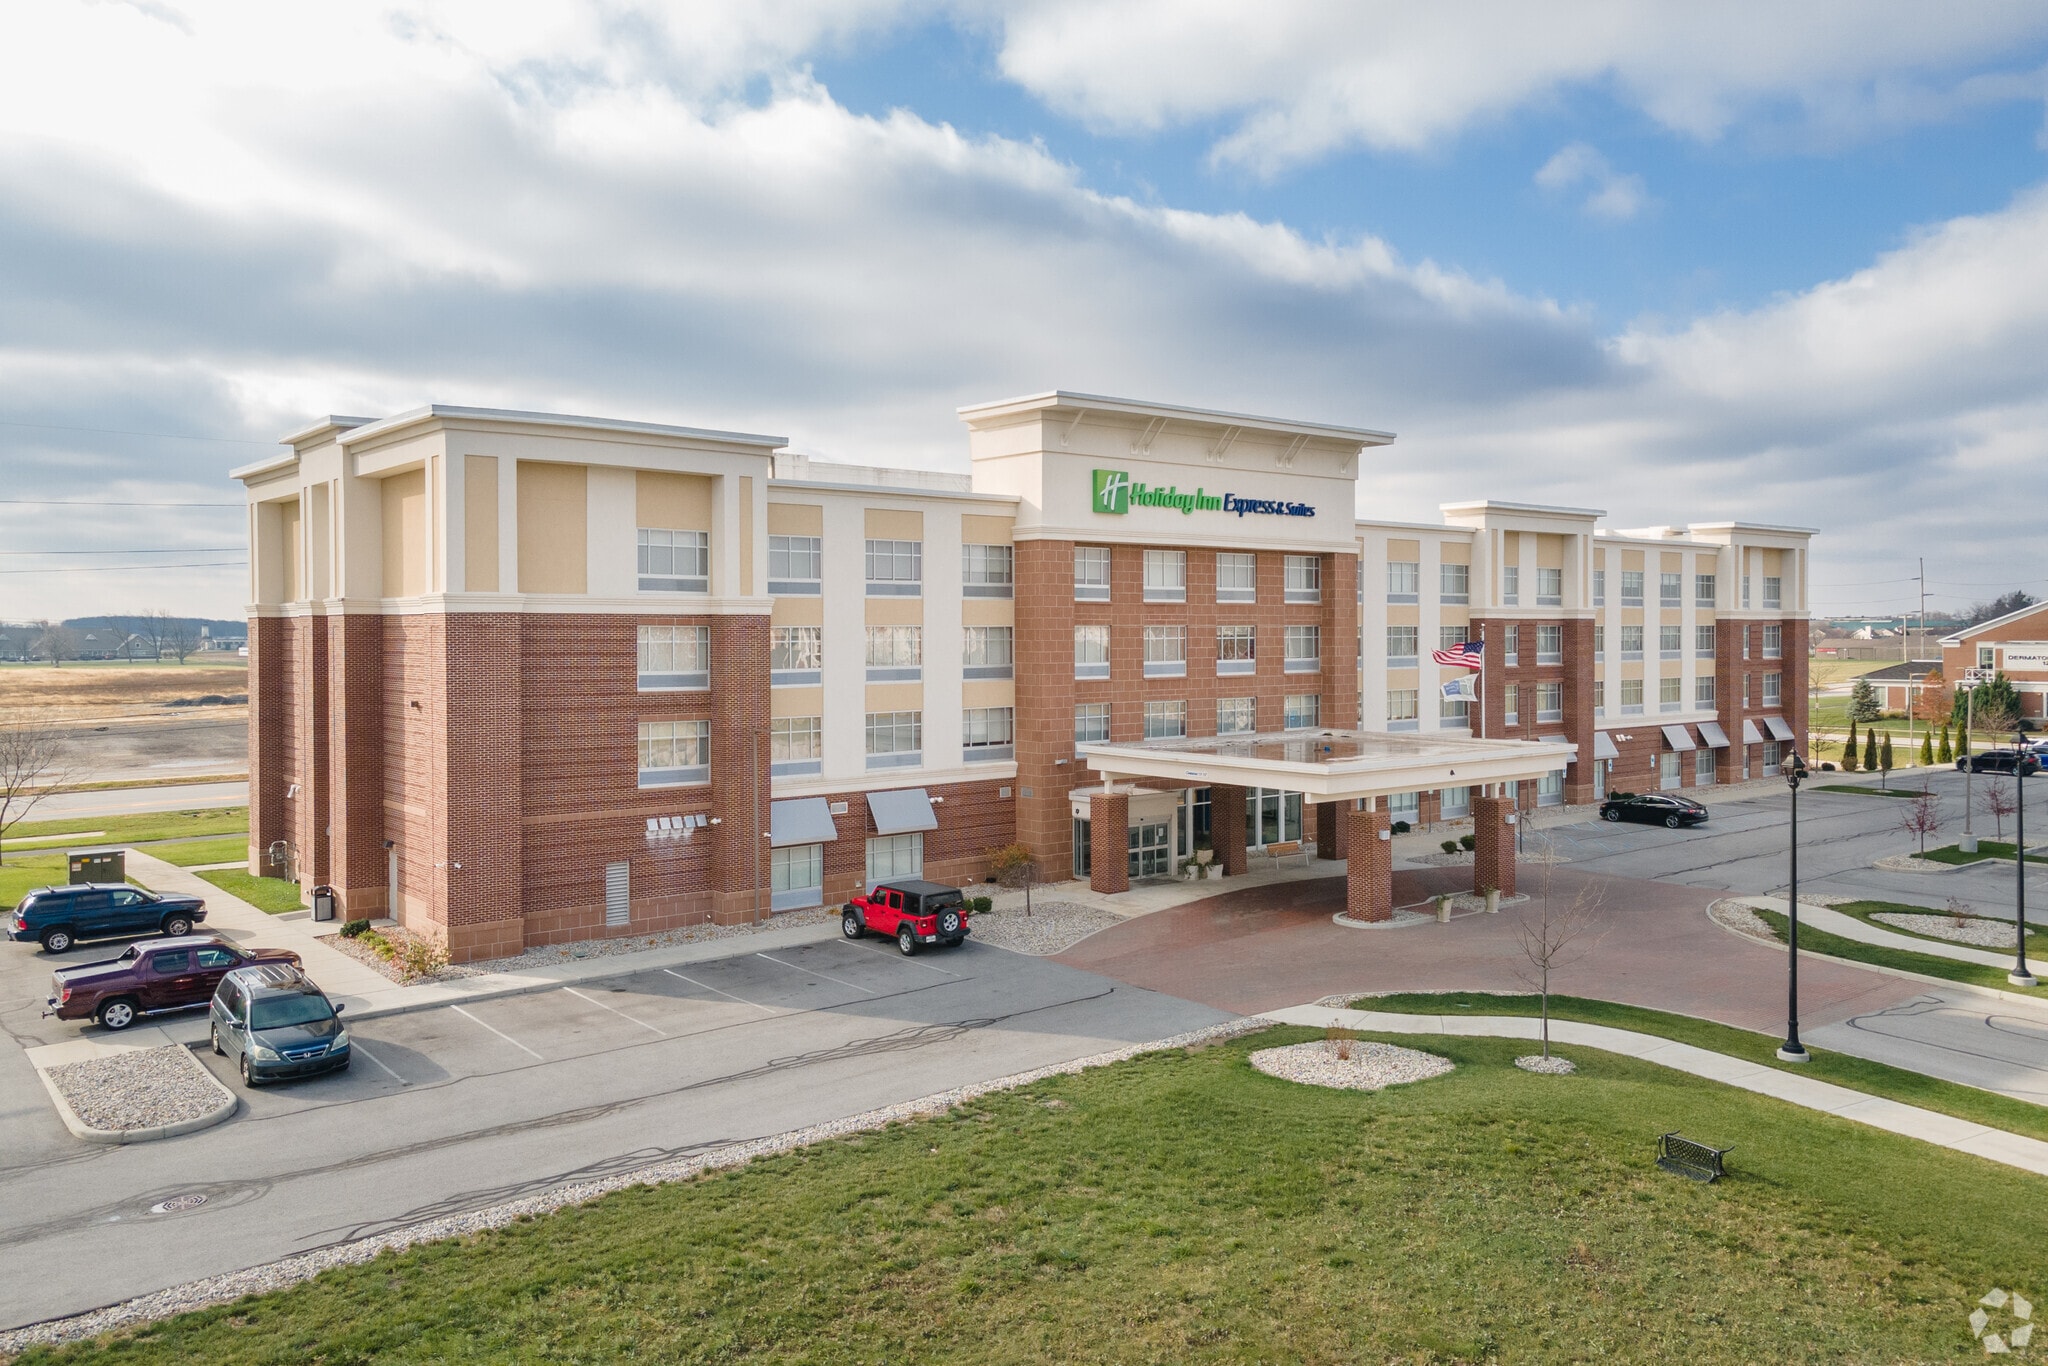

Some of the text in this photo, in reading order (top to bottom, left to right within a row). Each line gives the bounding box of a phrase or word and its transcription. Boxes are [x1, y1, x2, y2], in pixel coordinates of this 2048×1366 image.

[1130, 483, 1315, 517] Holiday Inn Express & Suites
